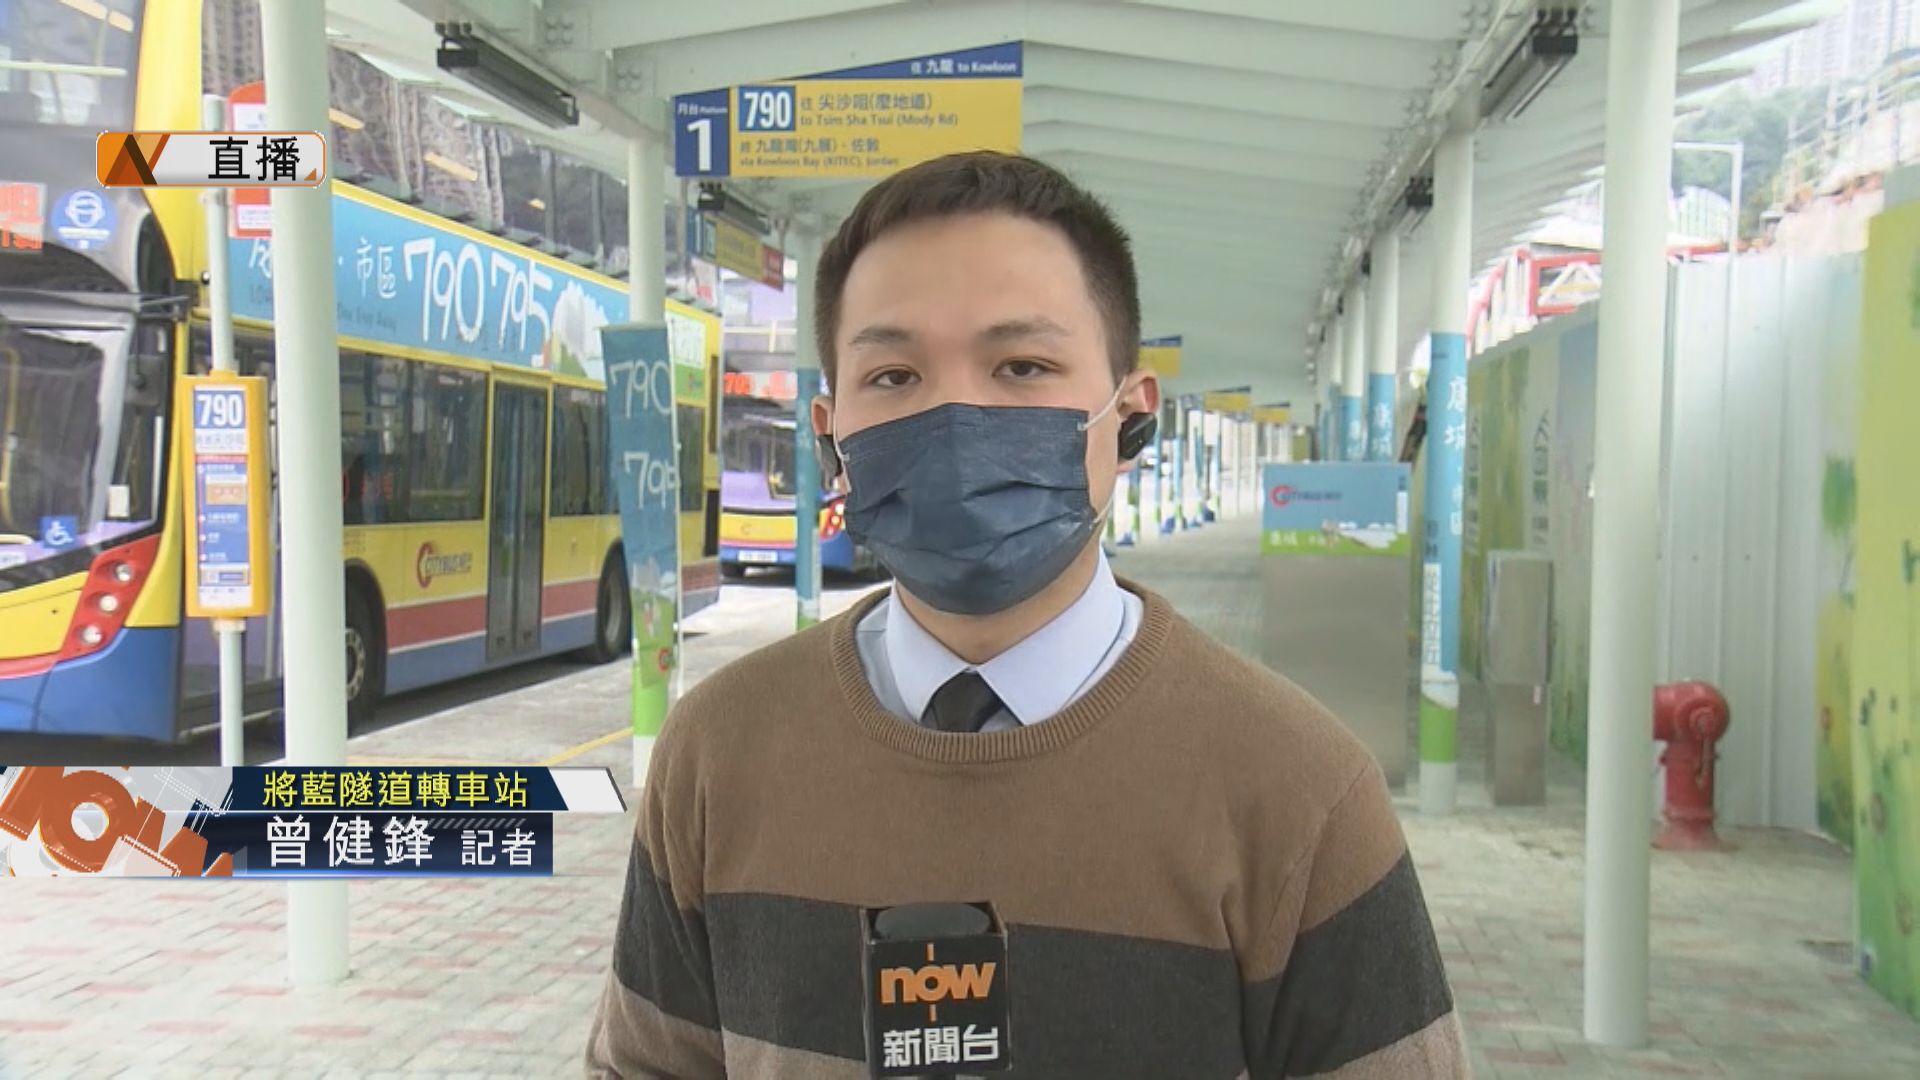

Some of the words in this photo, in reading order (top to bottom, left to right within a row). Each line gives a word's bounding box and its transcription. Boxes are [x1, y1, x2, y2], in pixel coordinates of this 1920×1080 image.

[971, 61, 1017, 73] Kowloon
[743, 91, 792, 129] 790
[800, 115, 813, 126] to
[816, 115, 843, 126] Tsim
[846, 115, 867, 126] Sha
[871, 115, 893, 126] Tsui
[896, 114, 935, 128] (Mody
[938, 114, 959, 127] Rd)
[687, 119, 711, 171] 1
[757, 157, 800, 166] Kowloon
[403, 237, 485, 342] 790
[490, 251, 554, 351] 795
[609, 359, 673, 419] 790
[197, 394, 243, 427] 790
[881, 962, 996, 1004] now
[883, 1024, 999, 1068] 新聞台
